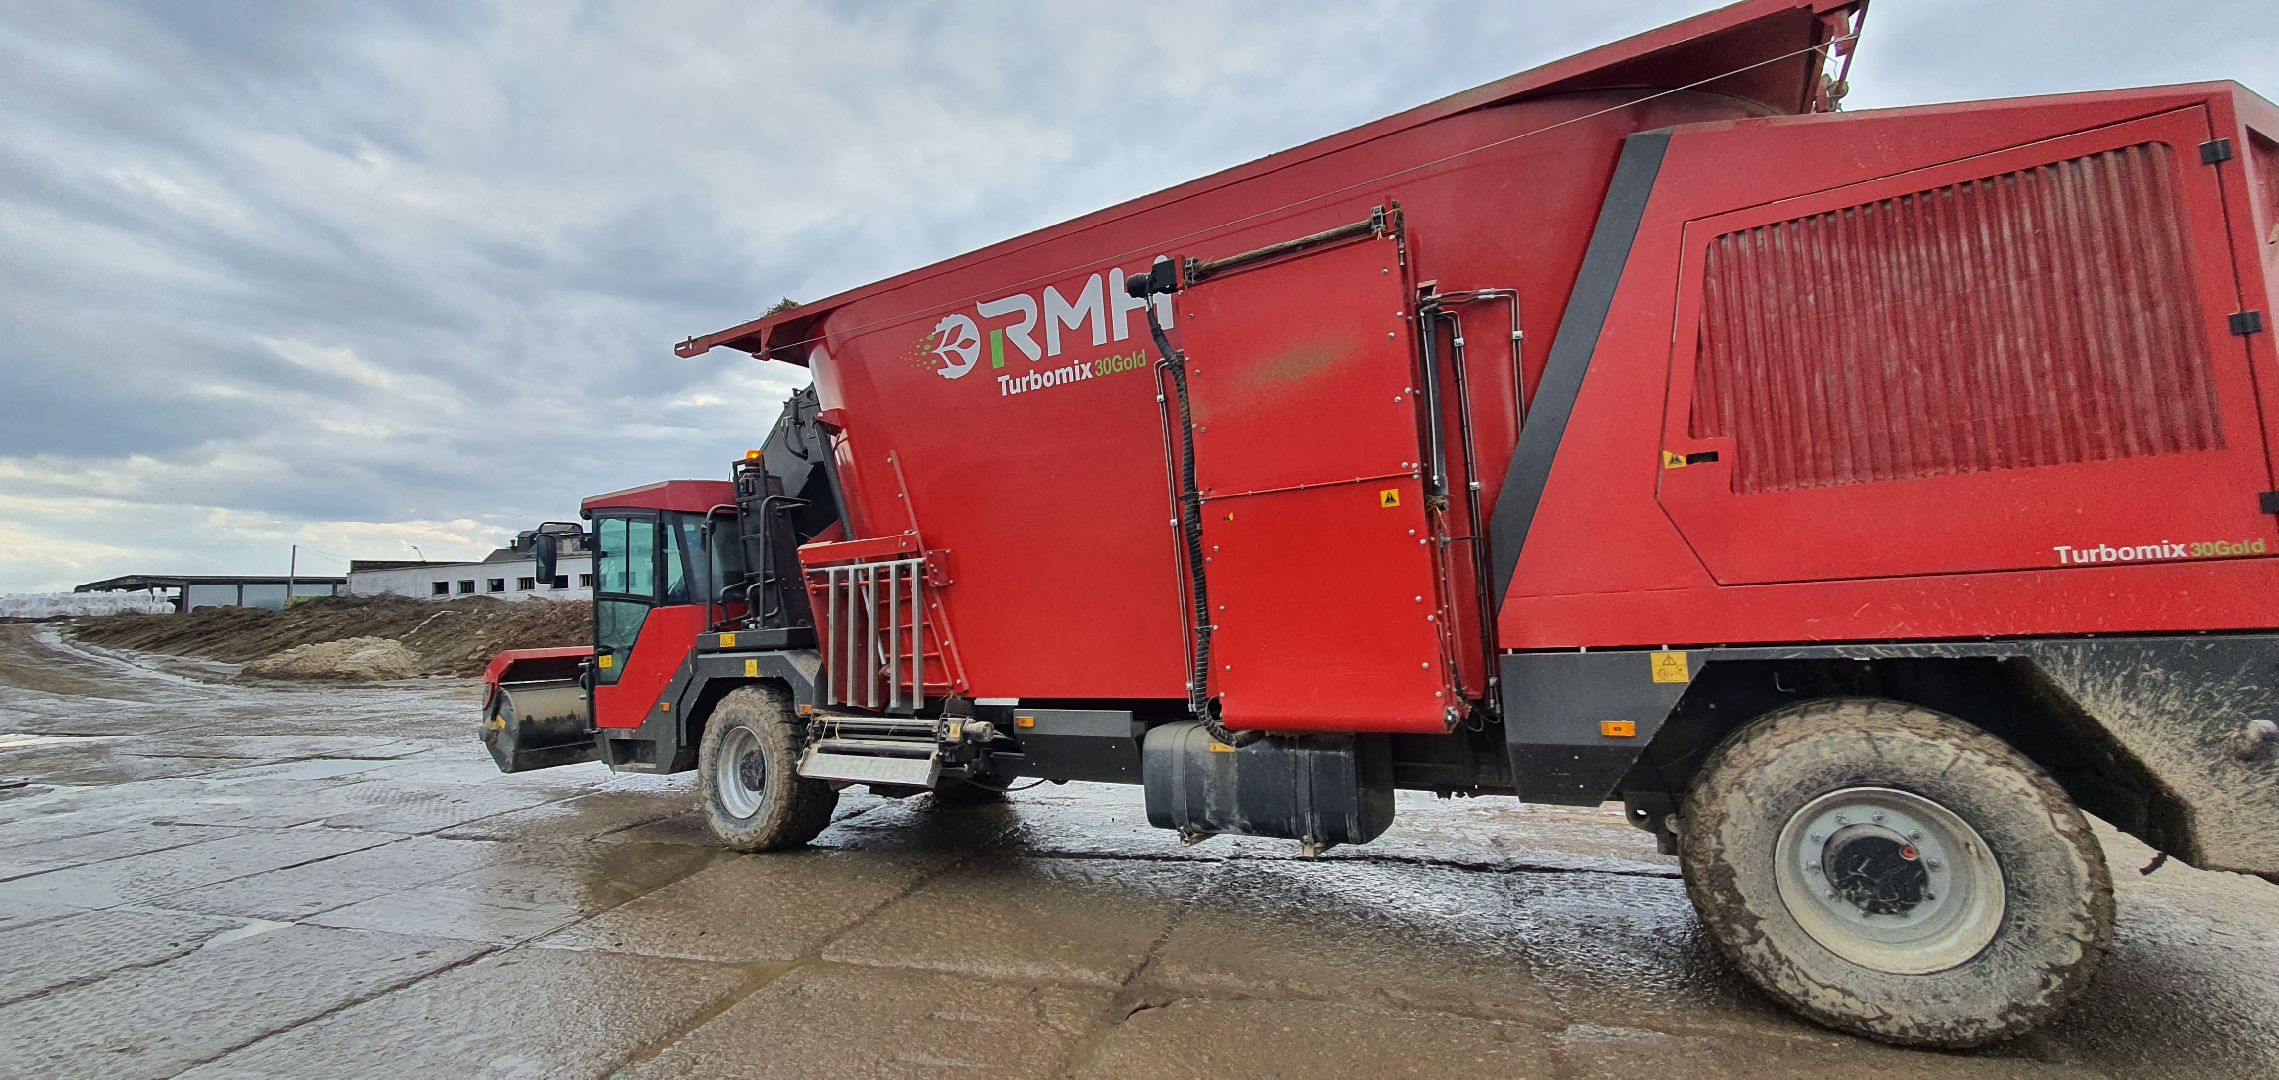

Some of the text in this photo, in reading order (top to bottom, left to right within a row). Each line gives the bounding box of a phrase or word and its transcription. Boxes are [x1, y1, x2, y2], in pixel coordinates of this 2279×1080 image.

[976, 255, 1174, 369] RMH
[998, 349, 1147, 396] Turbomix 30Gold
[2053, 538, 2267, 564] Turbomix 30Gold
